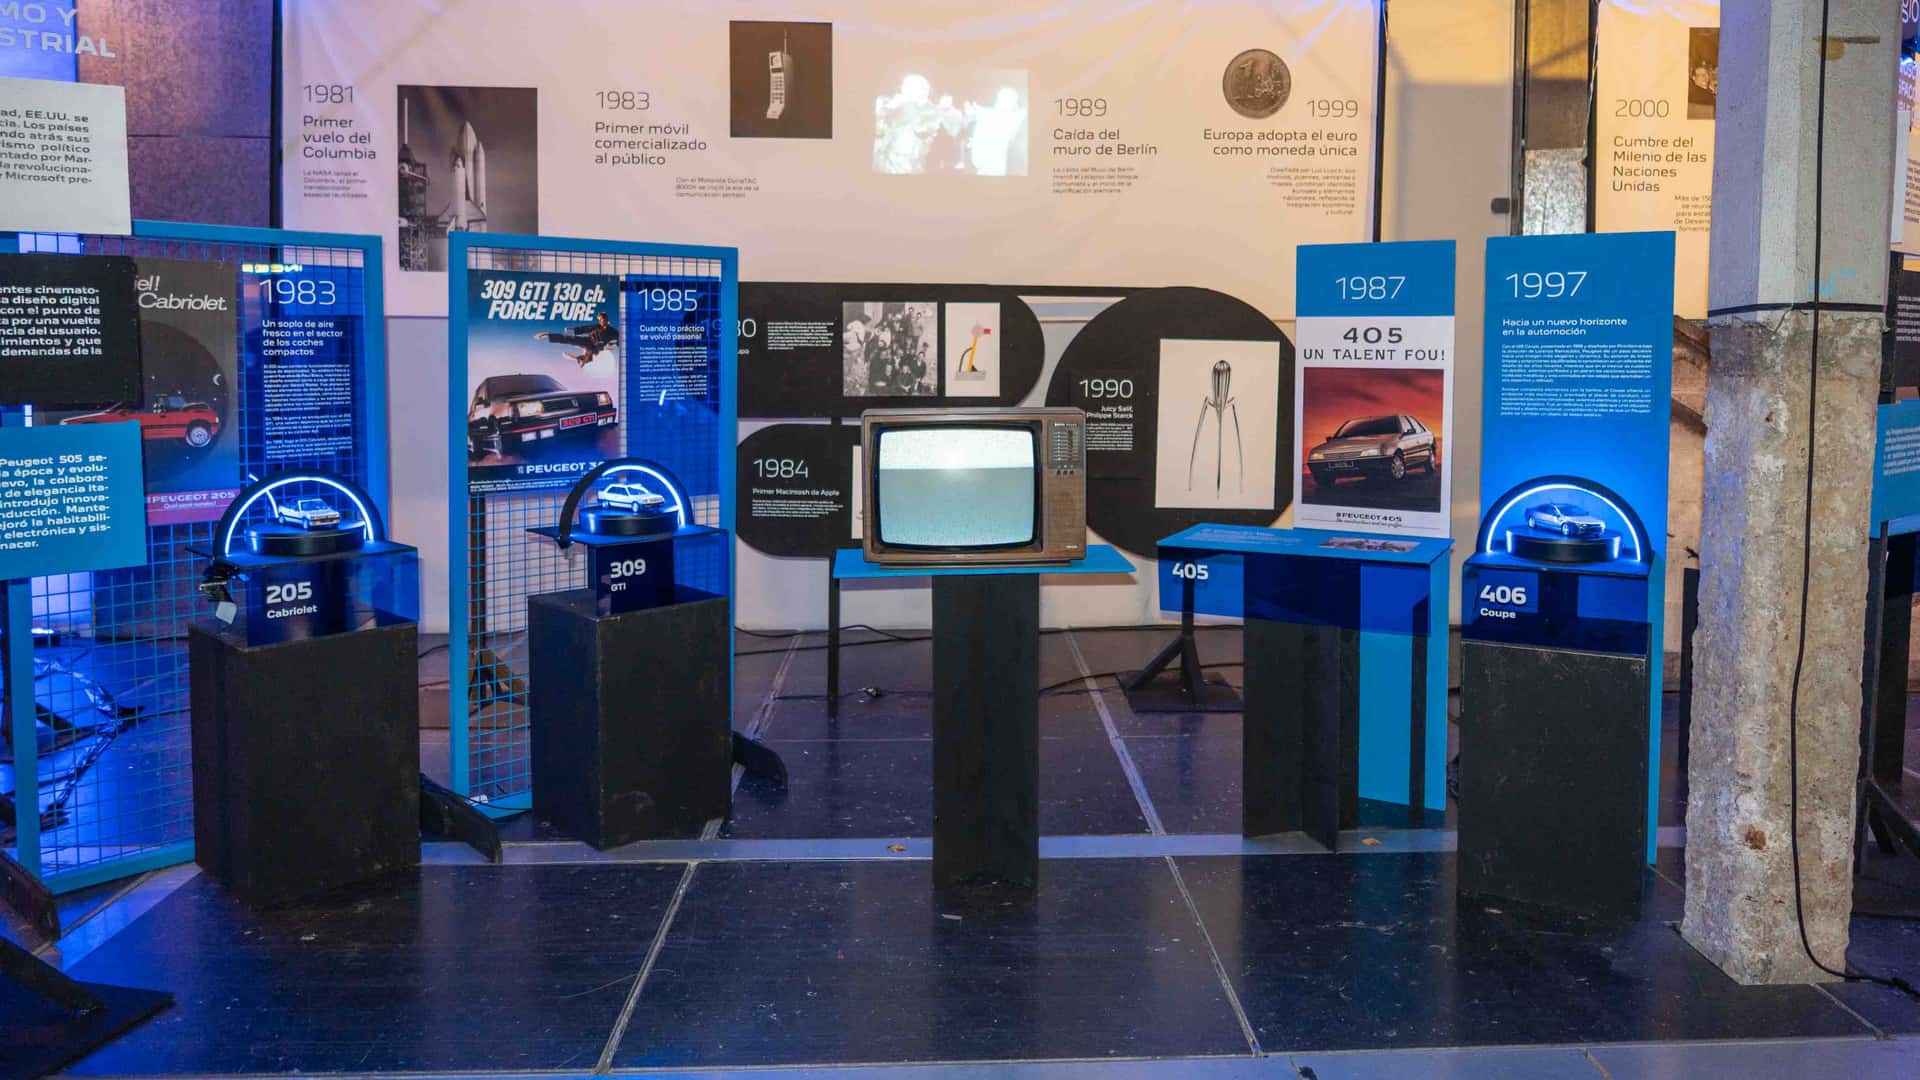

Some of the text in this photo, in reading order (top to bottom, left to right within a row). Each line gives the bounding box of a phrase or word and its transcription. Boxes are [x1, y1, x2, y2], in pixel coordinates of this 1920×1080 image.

[56, 7, 78, 28] Y
[303, 84, 354, 104] 1981
[595, 90, 650, 111] 1983
[1055, 98, 1107, 117] 1989
[1307, 99, 1359, 118] 1999
[1615, 99, 1670, 118] 2000
[25, 110, 70, 121] EE.UU.
[303, 115, 354, 128] Primer
[23, 120, 89, 133] Los países
[594, 122, 689, 135] Primer móvil
[29, 132, 63, 142] atrás
[66, 135, 90, 143] sus
[303, 131, 371, 144] vuelo del
[1053, 128, 1120, 140] Caída del
[1203, 128, 1358, 142] Europa adopta el euro
[594, 138, 707, 151] comercializado
[1613, 136, 1694, 148] Cumbre del
[40, 143, 90, 154] político
[303, 146, 376, 160] Columbia
[1053, 143, 1157, 155] muro de Berlín
[1213, 144, 1357, 156] como moneda única
[40, 154, 61, 162] por
[64, 155, 93, 163] Mar-
[594, 152, 666, 167] al público
[1613, 151, 1707, 162] Milenio de las
[13, 163, 92, 174] revoluciona-
[1613, 165, 1677, 177] Naciones
[5, 171, 92, 184] Microsoft pre-
[1612, 180, 1661, 192] Unidas
[35, 285, 100, 295] cinemato-
[1335, 276, 1406, 300] 1987
[1505, 271, 1588, 298] 1997
[259, 279, 336, 305] 1983
[480, 280, 606, 303] 309 GTI 130 ch.
[12, 295, 100, 306] diseño digital
[638, 288, 697, 311] 1985
[27, 306, 39, 315] el
[42, 306, 81, 317] punto
[84, 306, 101, 315] de
[487, 300, 597, 321] FORCE PURE
[12, 318, 32, 327] por
[62, 316, 101, 325] vuelta
[262, 320, 335, 330] Un soplo de aire
[1502, 318, 1530, 327] Hacia
[1579, 318, 1628, 327] horizonte
[27, 327, 47, 335] del
[49, 326, 101, 335] usuario.
[262, 329, 291, 337] fresco
[639, 324, 668, 332] Cuando
[676, 324, 705, 333] práctico
[1527, 328, 1587, 336] automoción
[650, 333, 671, 341] volvió
[672, 333, 702, 341] pasional
[1342, 327, 1403, 344] 405
[64, 338, 73, 346] y
[76, 338, 102, 346] que
[1, 347, 103, 356] demandas de la
[263, 348, 314, 357] compactos
[1303, 349, 1445, 360] UN TALENT FOU!
[1080, 379, 1134, 398] 1990
[59, 454, 83, 464] 505
[14, 463, 109, 478] época y evolu-
[526, 462, 586, 474] PEUGEOT
[753, 458, 809, 478] 1984
[33, 474, 109, 486] la colabora-
[5, 484, 110, 498] de elegancia ita-
[62, 495, 110, 505] innova-
[66, 504, 110, 513] Mante-
[31, 513, 111, 526] la habitabili-
[4, 523, 111, 539] electrónica y sis-
[610, 558, 646, 579] 309
[1172, 562, 1209, 580] 405
[266, 581, 313, 604] 205
[611, 582, 627, 592] GTI
[1480, 584, 1527, 605] 406
[267, 604, 318, 619] Cabriolet
[1480, 608, 1516, 620] Coupe
